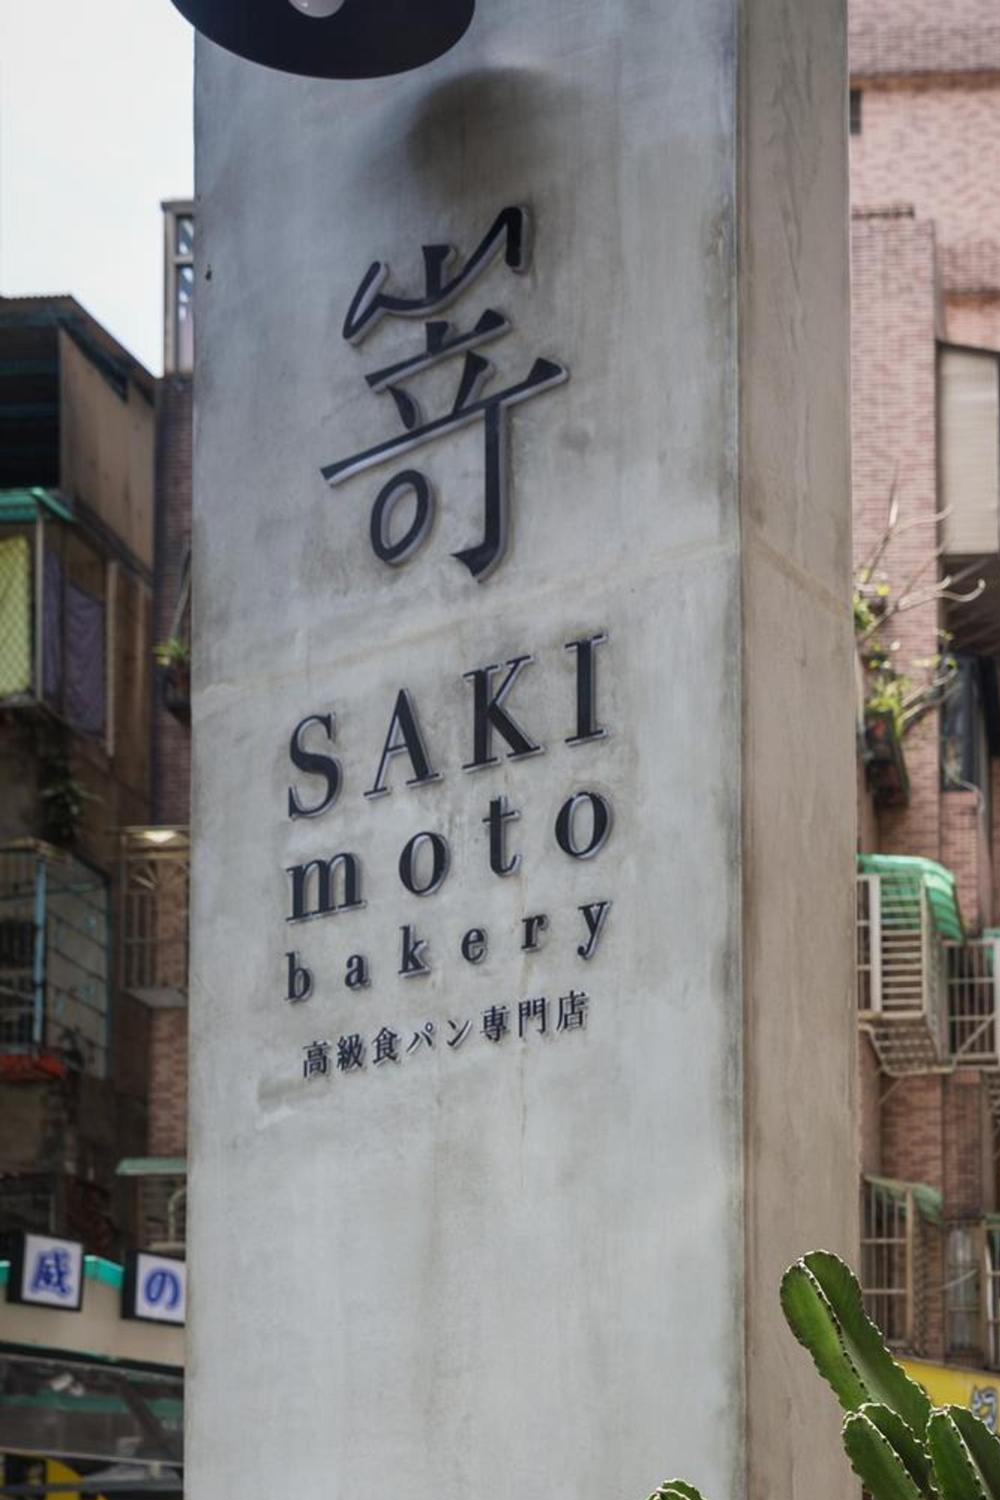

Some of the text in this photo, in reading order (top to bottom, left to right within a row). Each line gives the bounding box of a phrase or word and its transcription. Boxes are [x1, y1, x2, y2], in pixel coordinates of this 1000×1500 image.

[288, 633, 609, 822] SAKI
[285, 791, 613, 924] moto
[284, 901, 611, 1003] bakery
[301, 989, 590, 1079] 高級食パン専門店
